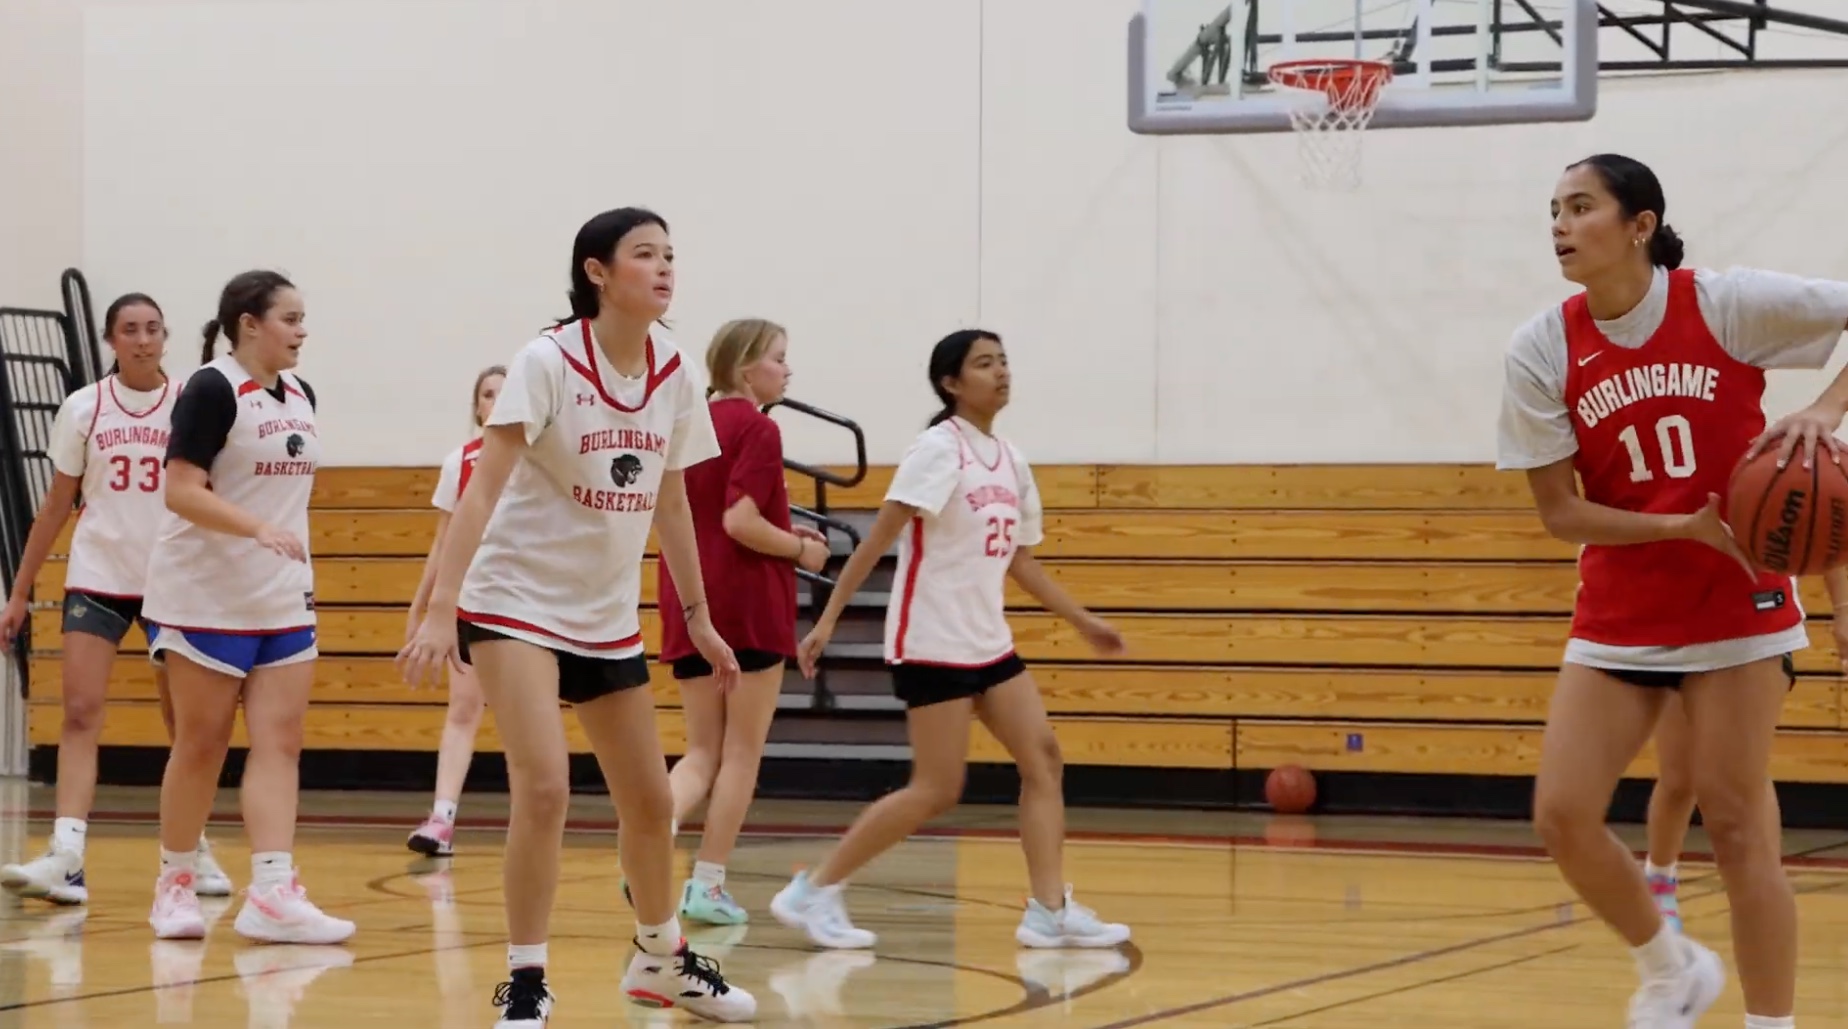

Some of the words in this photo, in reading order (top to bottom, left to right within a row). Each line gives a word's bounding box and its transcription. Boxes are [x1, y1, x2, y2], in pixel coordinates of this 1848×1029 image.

[1577, 363, 1720, 428] BURLINGAME
[95, 426, 169, 451] BURLINGAM
[579, 429, 666, 457] BURLINGAM
[1618, 414, 1697, 482] 10
[110, 455, 160, 493] 33
[254, 461, 316, 476] BASKETBAL
[573, 485, 656, 512] BASKETBAL
[985, 516, 1016, 558] 25
